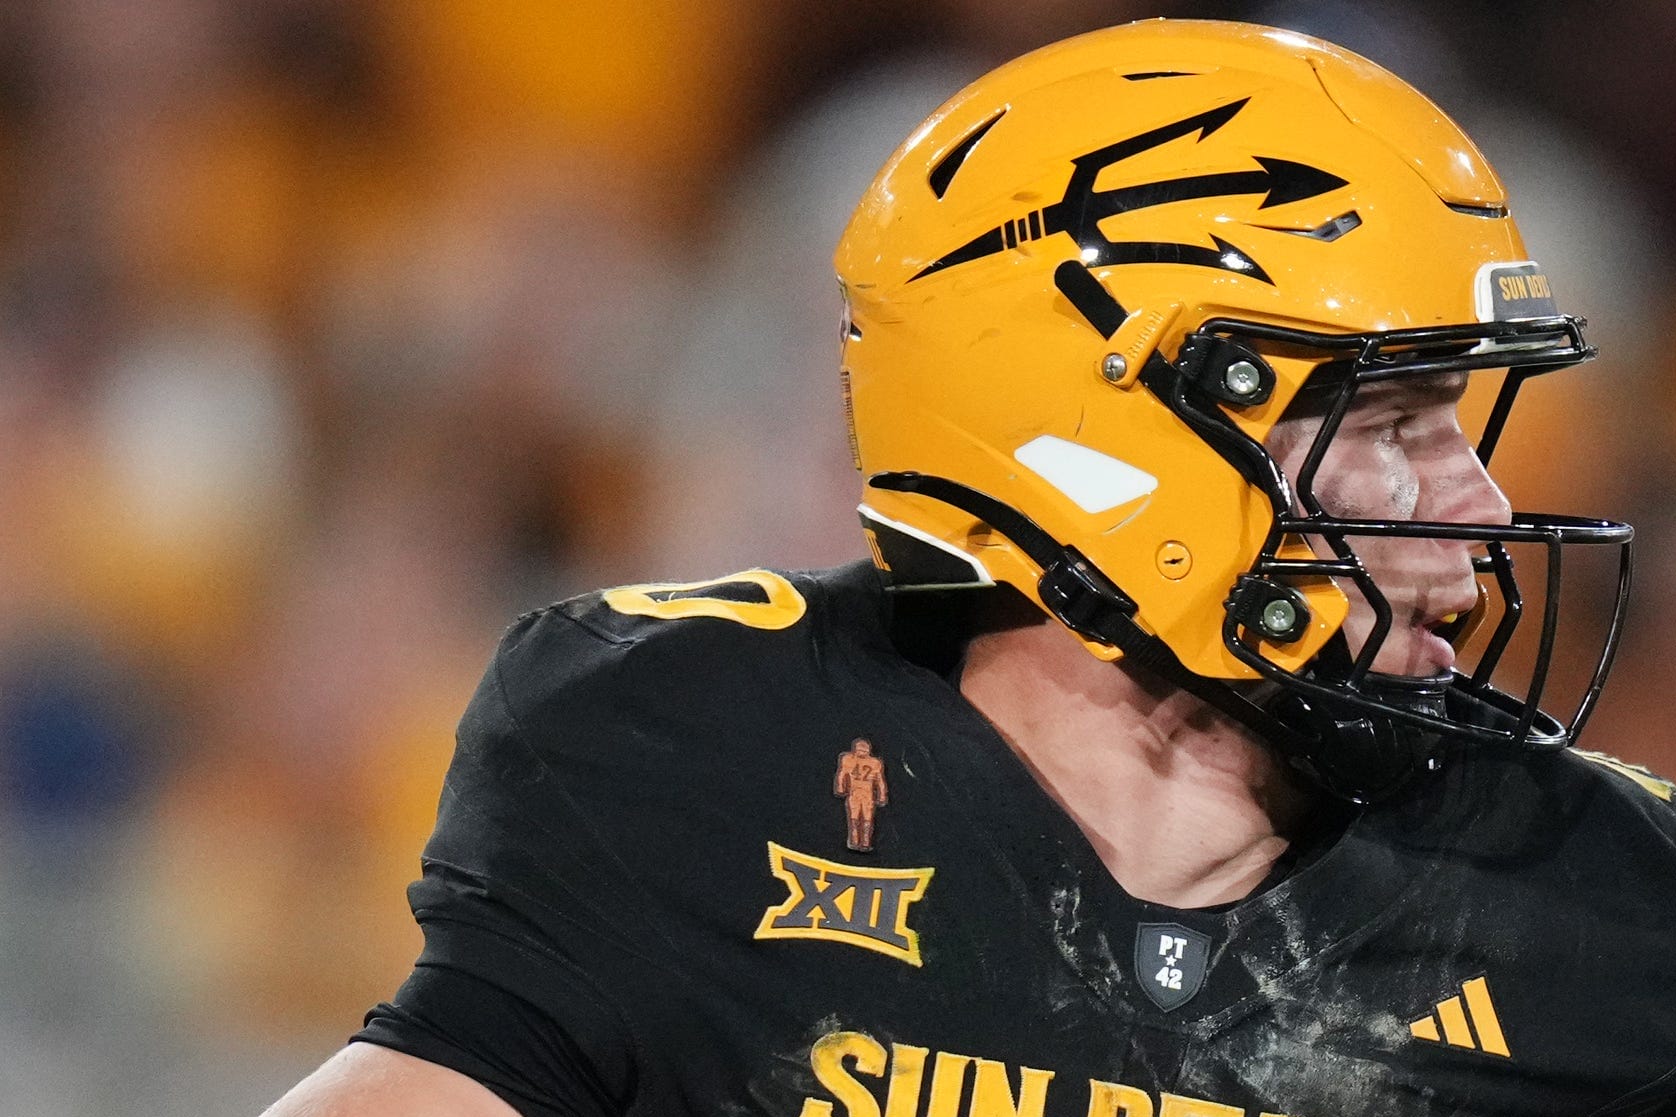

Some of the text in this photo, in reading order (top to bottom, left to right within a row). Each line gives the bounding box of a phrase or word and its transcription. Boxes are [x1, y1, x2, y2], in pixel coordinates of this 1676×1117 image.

[1498, 275, 1528, 301] SUN
[851, 763, 873, 782] 42
[763, 848, 928, 960] XII
[1158, 934, 1188, 959] PT
[1155, 966, 1183, 990] 42
